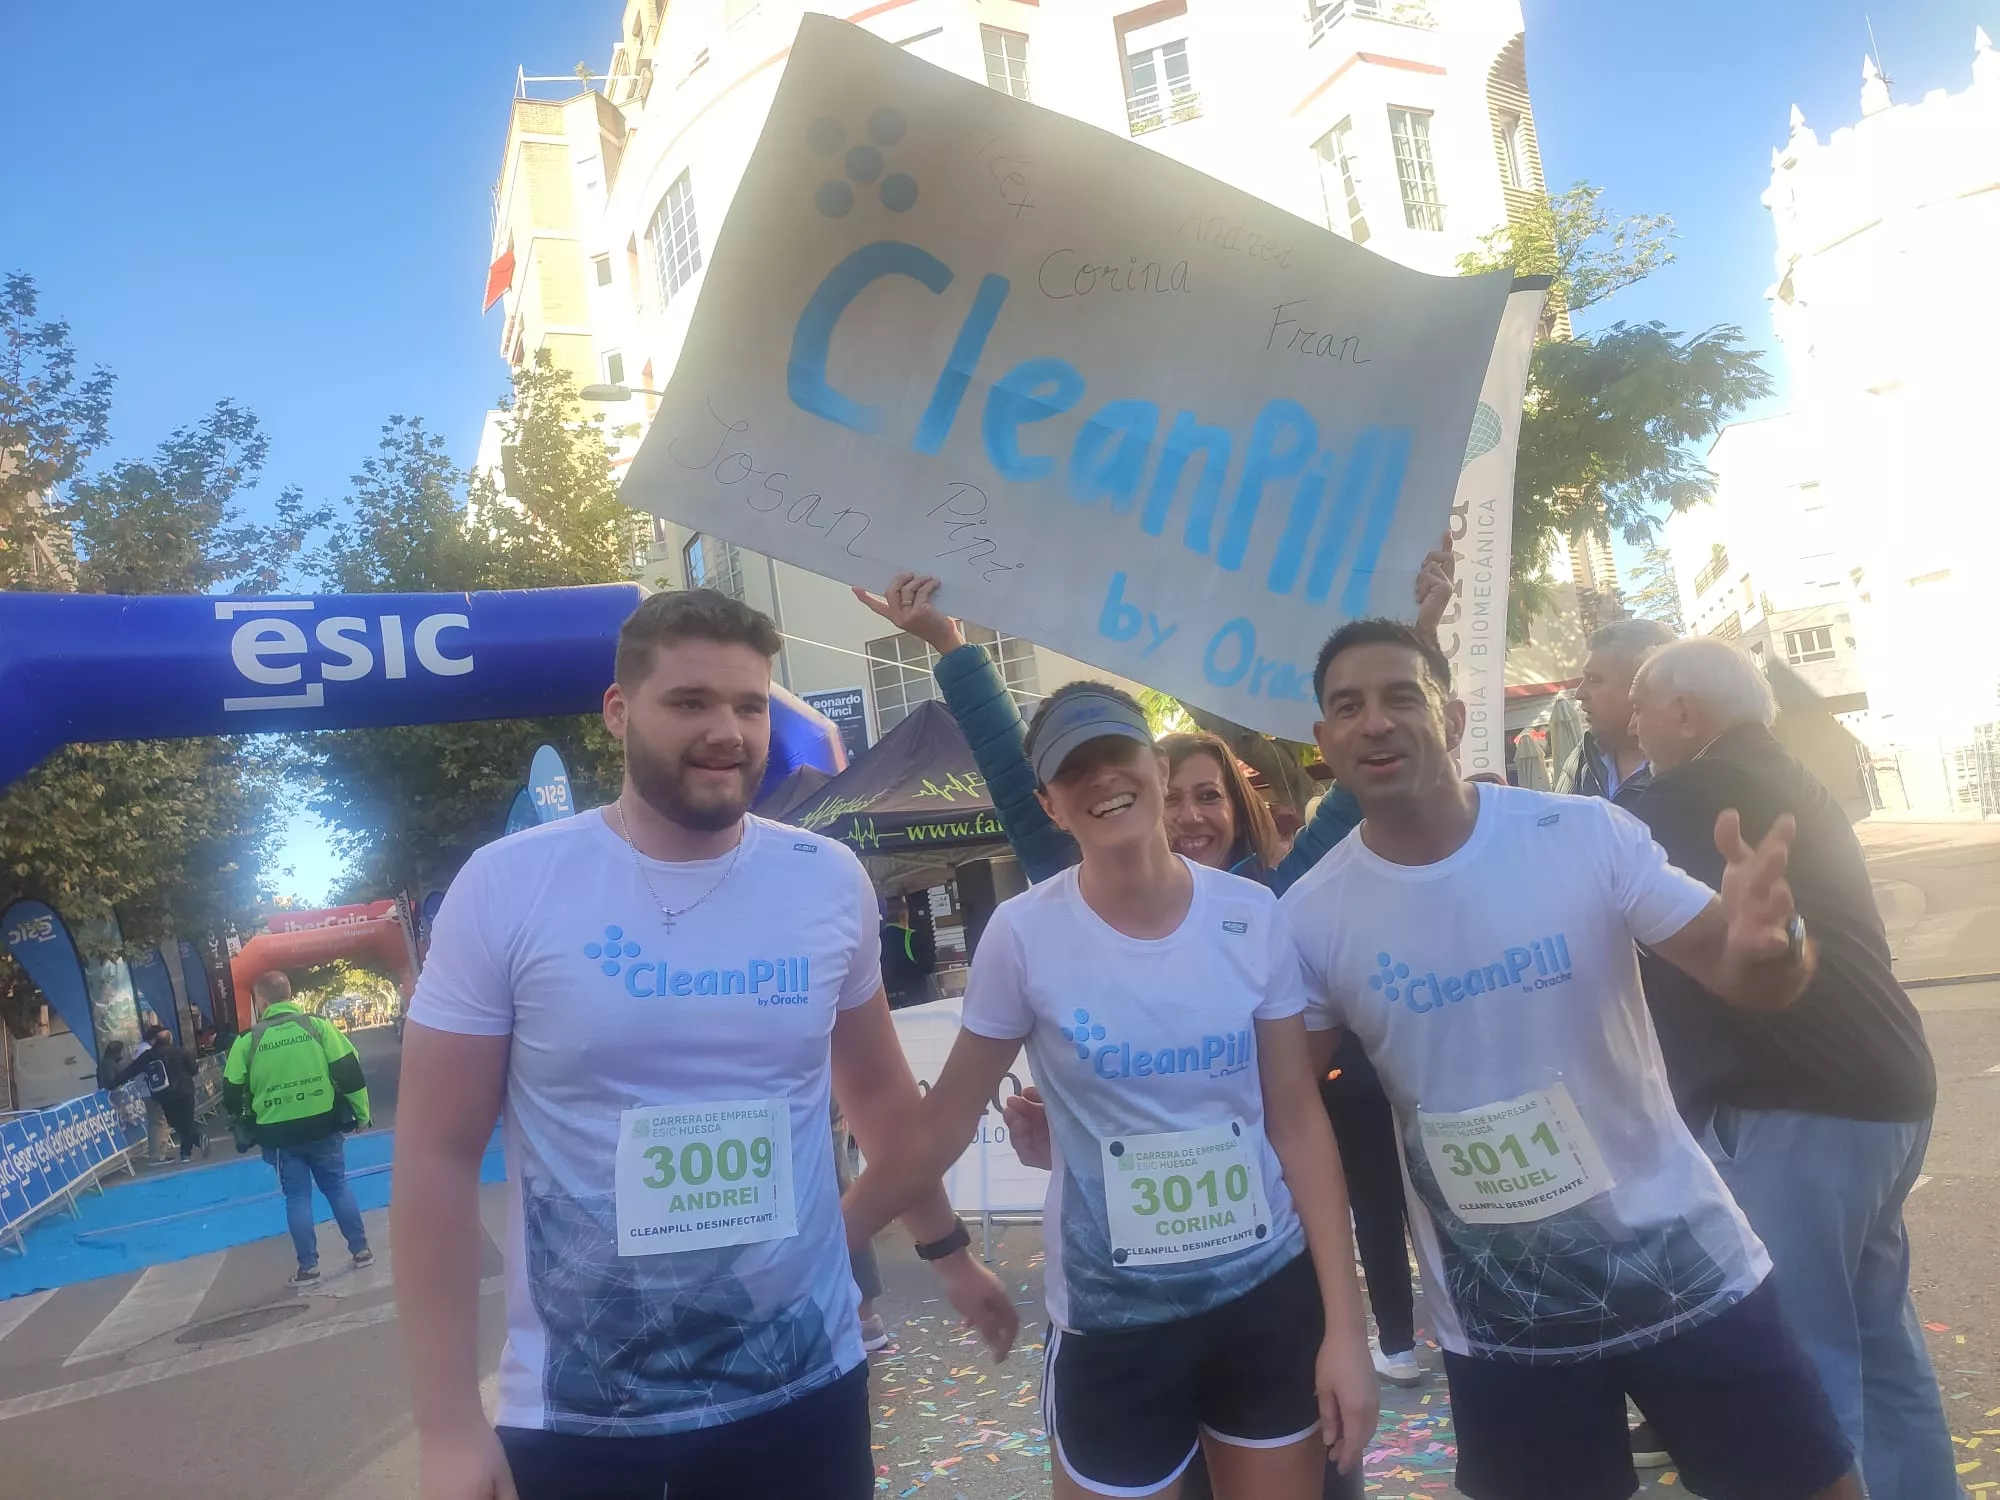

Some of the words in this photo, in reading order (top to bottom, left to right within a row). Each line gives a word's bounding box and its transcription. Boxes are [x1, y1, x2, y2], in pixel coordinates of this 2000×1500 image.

[1039, 248, 1192, 299] Corina
[1266, 300, 1371, 364] Fran
[787, 241, 1413, 617] CleanPill
[1470, 498, 1496, 657] BIOMECÁNICA
[1098, 571, 1178, 659] by
[1471, 667, 1488, 684] Y
[1471, 684, 1489, 769] OLOGÍA
[625, 957, 809, 997] CleanPill
[1404, 933, 1572, 1013] CleanPill
[758, 998, 769, 1008] by
[771, 994, 809, 1006] Orache
[1093, 1030, 1251, 1080] CleanPill
[651, 1115, 702, 1127] CARRERA
[705, 1113, 719, 1122] DE
[721, 1109, 769, 1120] EMPRESAS
[679, 1123, 721, 1136] HUESCA
[642, 1137, 773, 1189] 3009
[1136, 1149, 1178, 1161] CARRERA
[1181, 1147, 1195, 1157] DE
[1160, 1157, 1198, 1170] HUESCA
[1442, 1121, 1561, 1177] 3011
[1131, 1164, 1249, 1216] 3010
[1474, 1168, 1558, 1195] MIGUEL
[1506, 1178, 1584, 1209] DESINFECTANTE
[668, 1186, 759, 1214] ANDREI
[630, 1222, 693, 1238] CLEANPILL
[695, 1213, 774, 1231] DESINFECTANTE
[1155, 1210, 1236, 1236] CORINA
[1125, 1245, 1180, 1256] CLEANPILL
[1182, 1229, 1255, 1253] DESINFECTANTE
